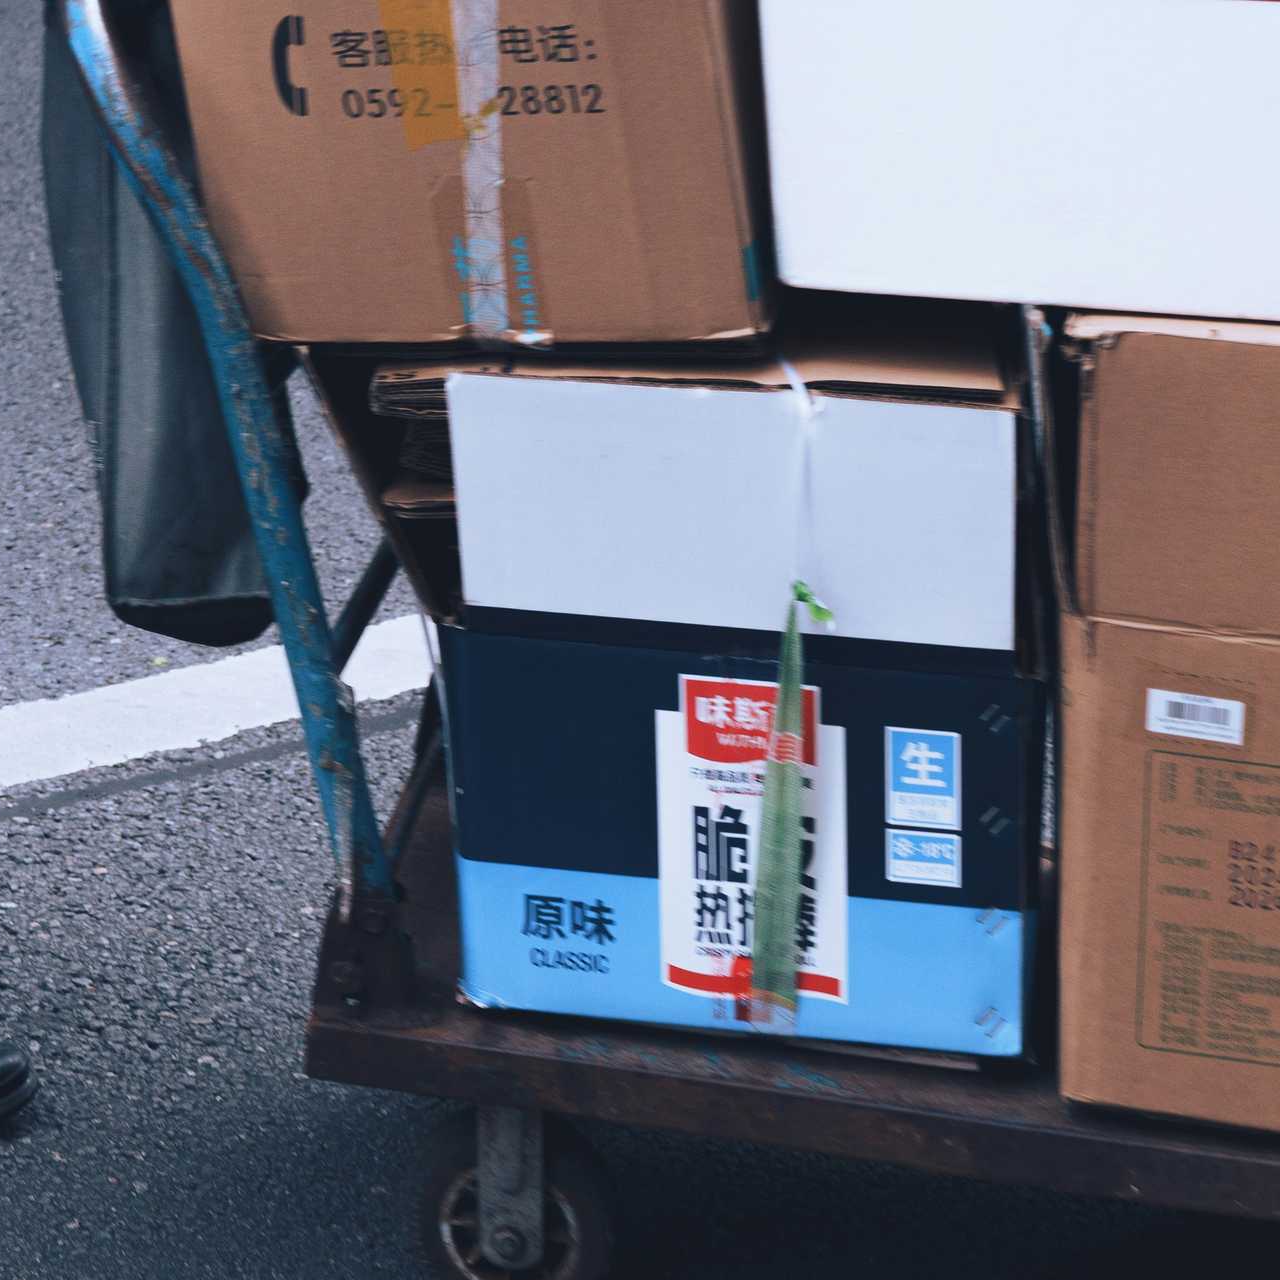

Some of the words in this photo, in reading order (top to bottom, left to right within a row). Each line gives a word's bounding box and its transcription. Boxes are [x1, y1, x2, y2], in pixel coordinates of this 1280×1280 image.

[695, 695, 775, 735] 味斯
[900, 742, 948, 788] 生
[522, 894, 617, 946] 原味
[529, 947, 610, 974] CLASSIC
